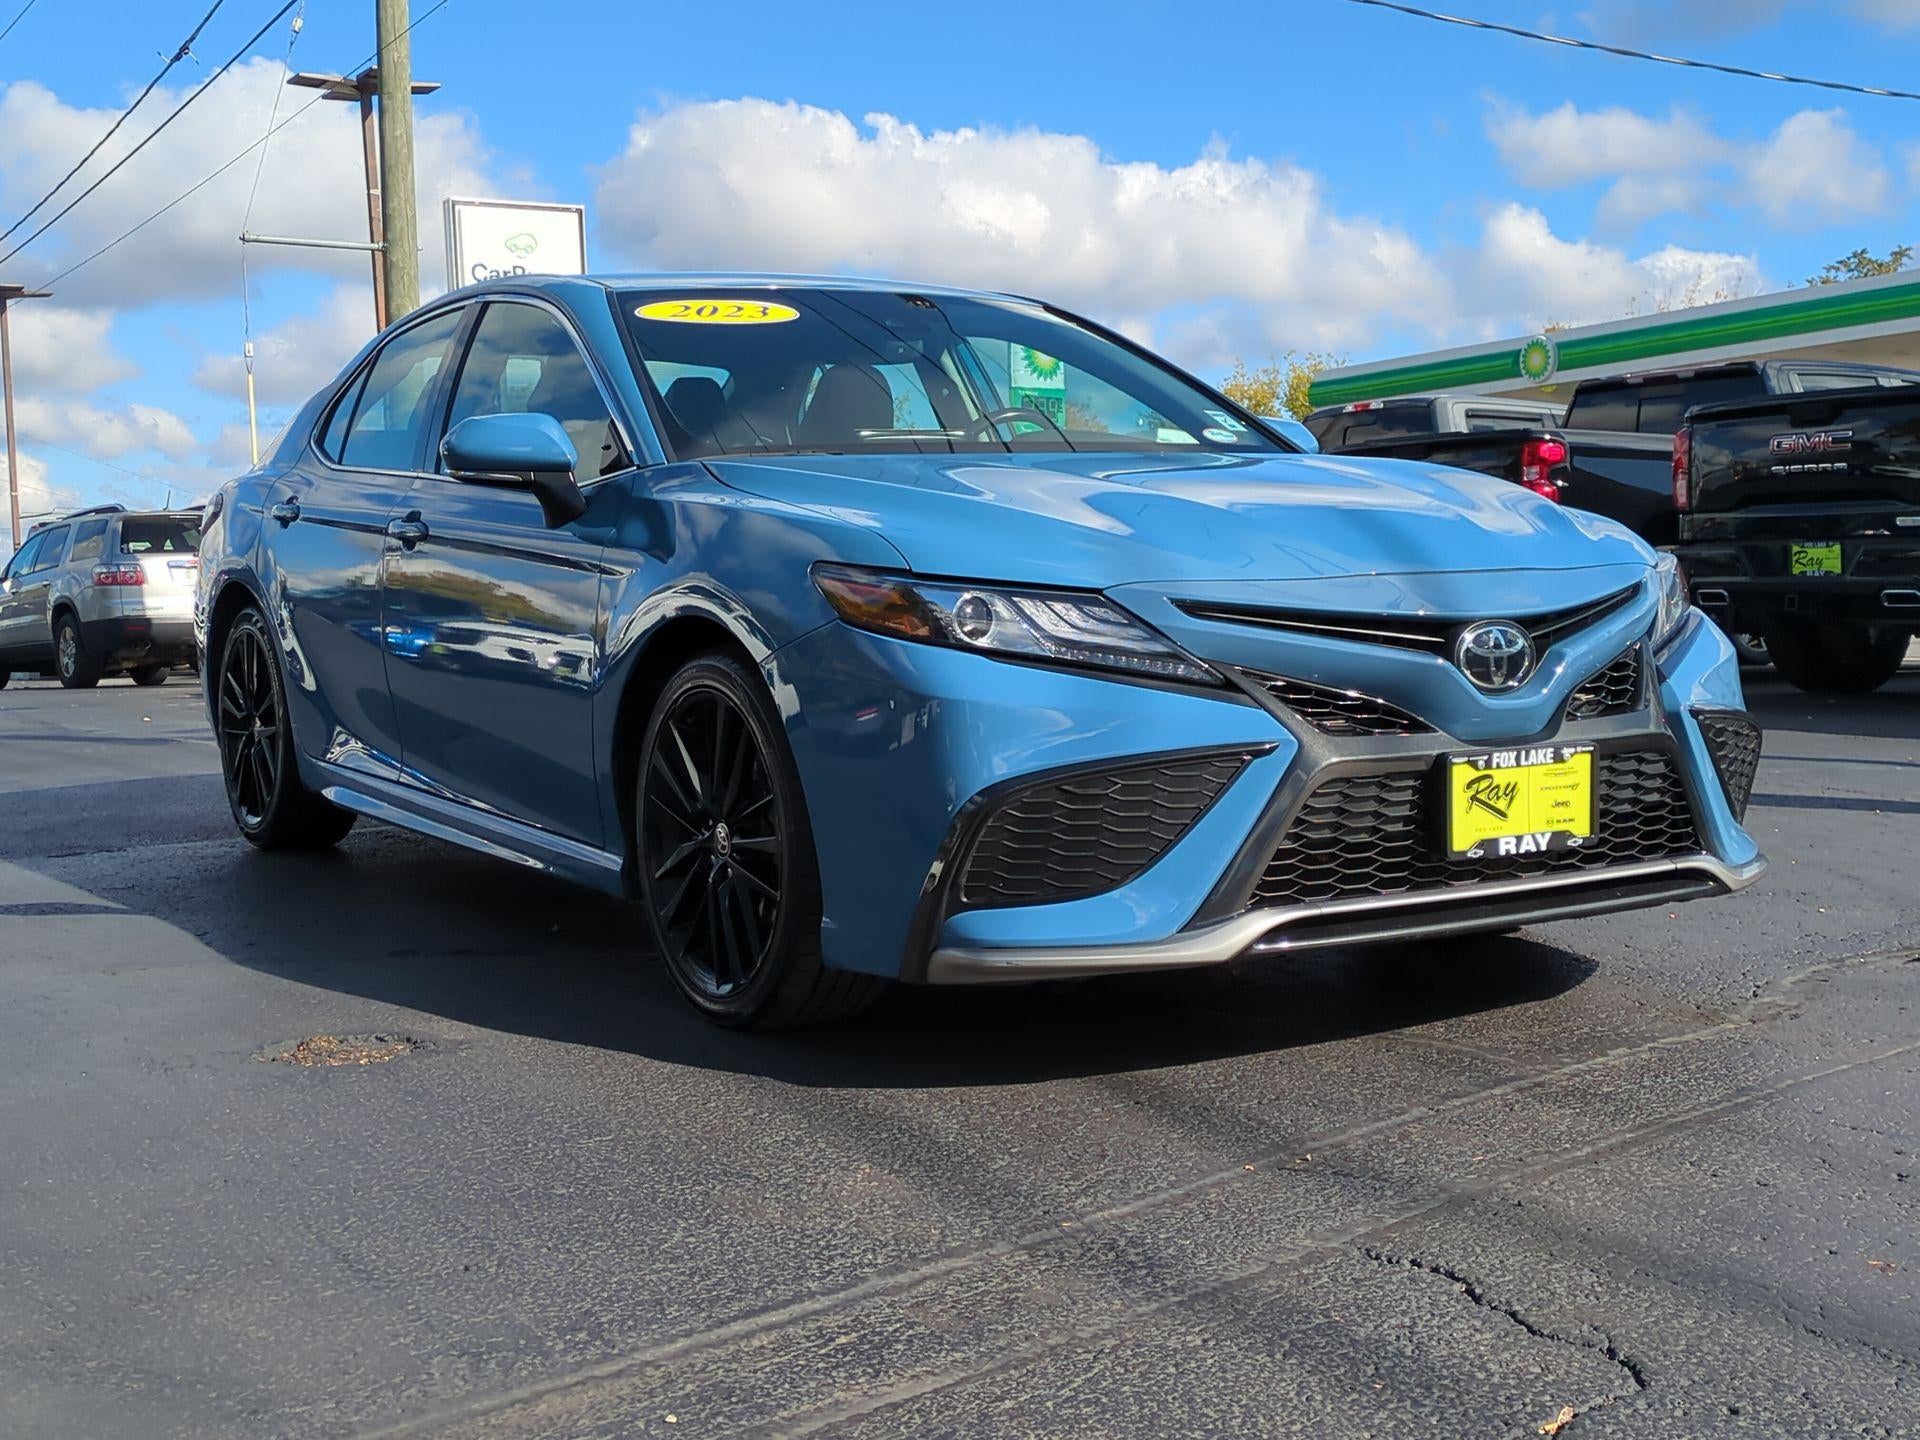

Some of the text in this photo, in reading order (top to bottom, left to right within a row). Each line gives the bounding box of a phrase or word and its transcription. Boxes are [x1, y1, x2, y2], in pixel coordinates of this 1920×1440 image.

[471, 263, 532, 281] Car
[670, 304, 770, 319] 2023
[1769, 430, 1853, 455] GMC
[1771, 462, 1848, 475] SIERRA
[1793, 550, 1824, 571] Ray
[1492, 751, 1517, 769] FOX
[1521, 747, 1555, 766] LAKE
[1464, 774, 1520, 821] Ray
[1498, 831, 1553, 856] RAY
